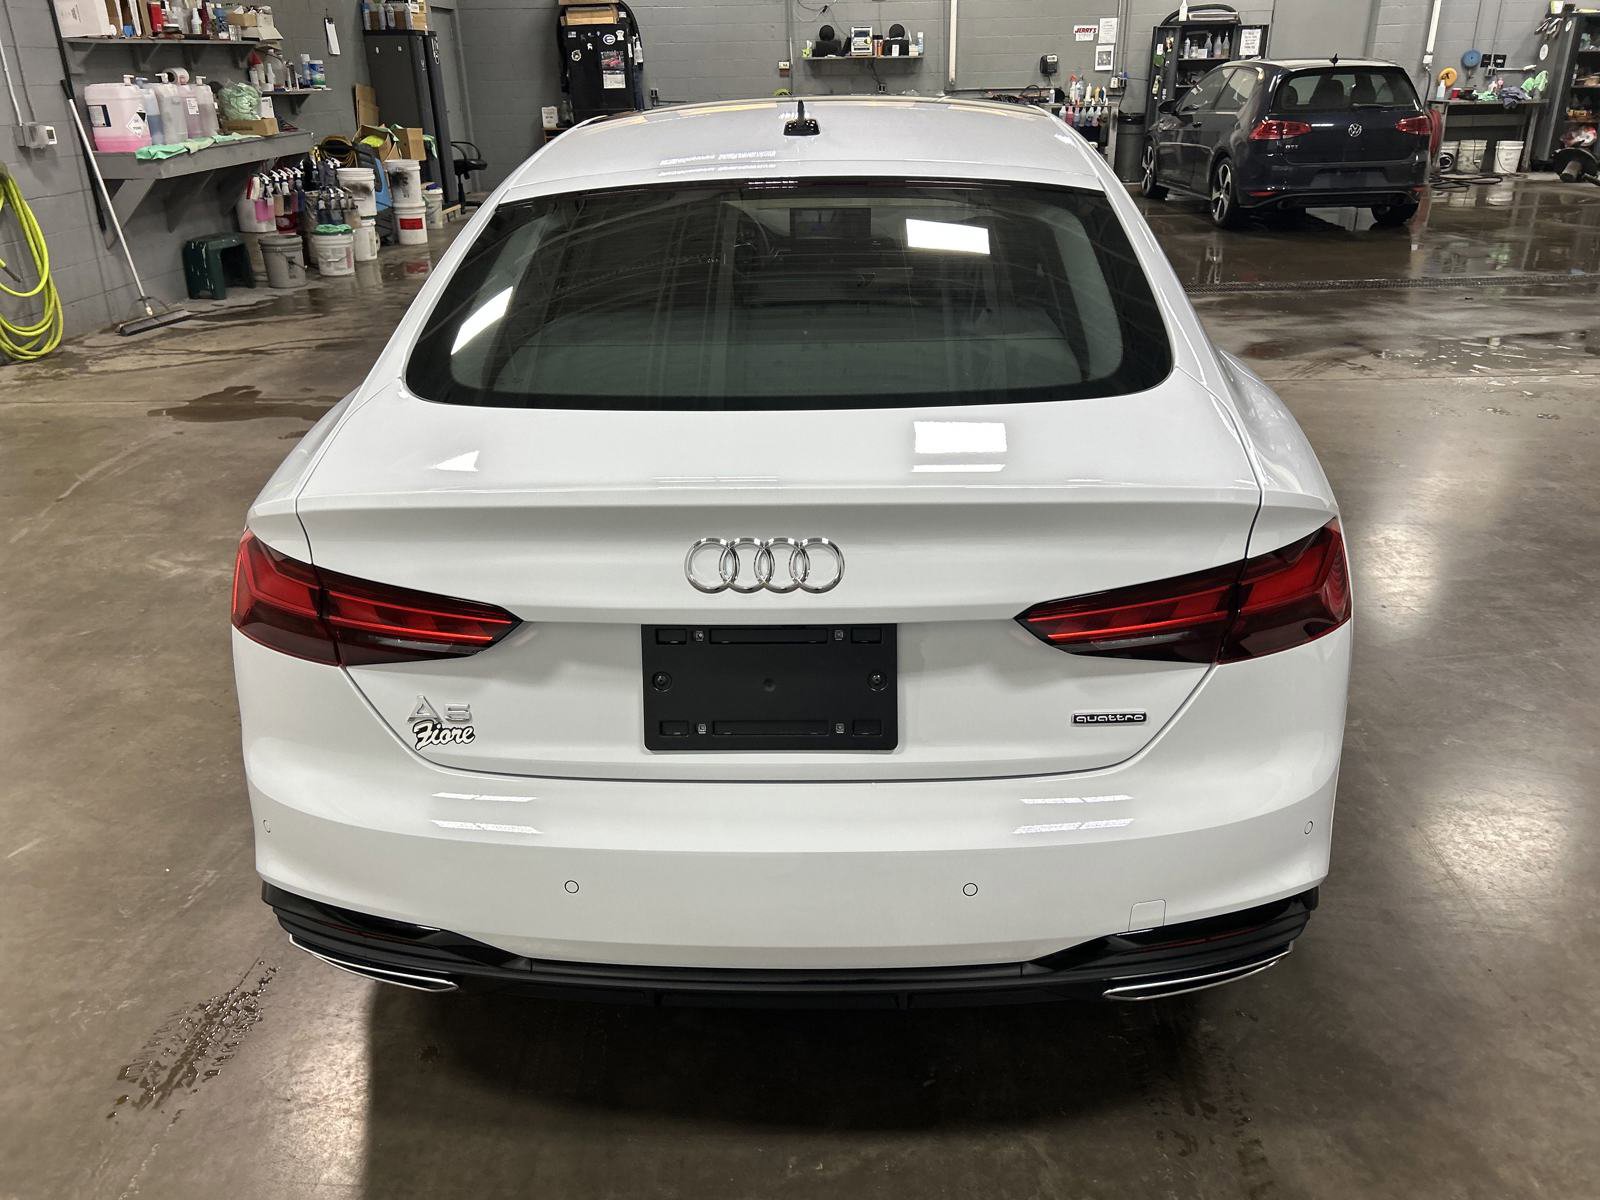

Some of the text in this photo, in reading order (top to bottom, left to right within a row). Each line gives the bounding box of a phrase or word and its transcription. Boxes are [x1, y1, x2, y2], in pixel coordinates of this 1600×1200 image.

[407, 694, 473, 723] A5
[1076, 714, 1144, 723] quattro
[412, 719, 475, 751] Fiore
